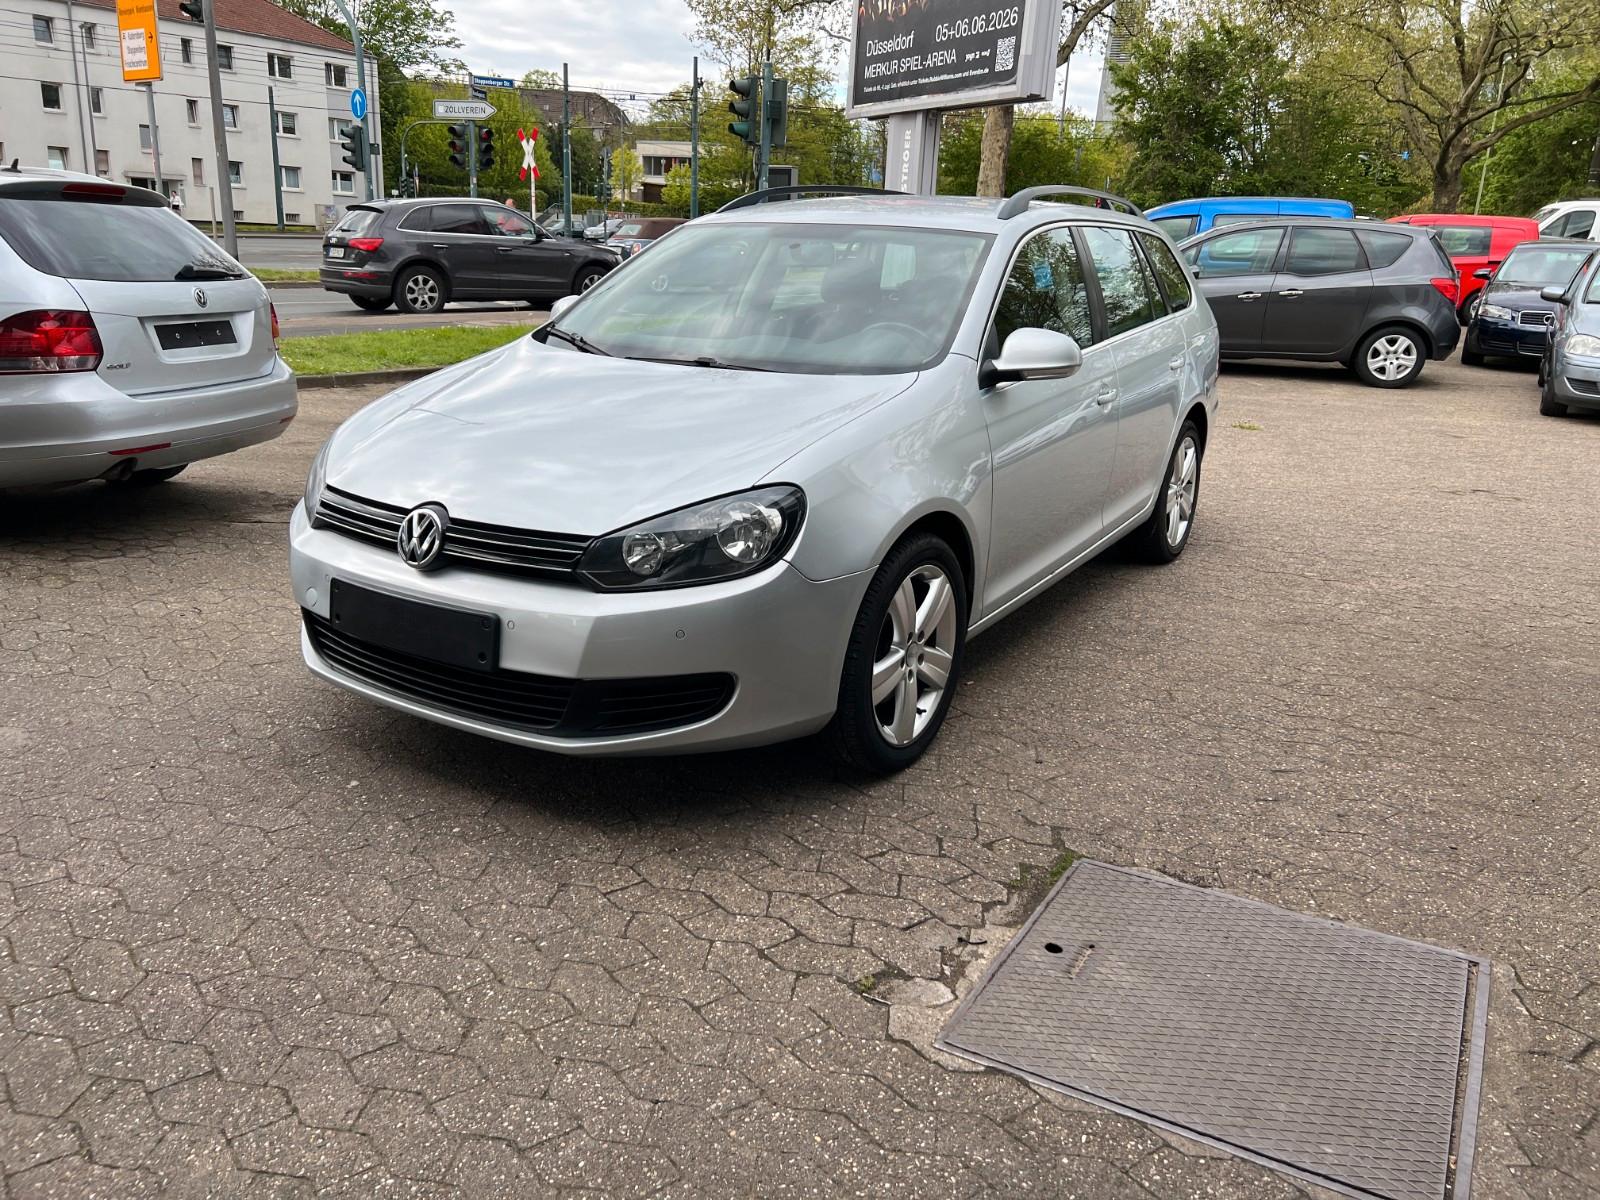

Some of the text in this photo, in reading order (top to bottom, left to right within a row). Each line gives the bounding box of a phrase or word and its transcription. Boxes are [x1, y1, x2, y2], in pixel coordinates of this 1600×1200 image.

[935, 6, 1019, 43] 05+06.06.2026
[866, 30, 915, 57] Düsseldorf
[864, 59, 899, 79] MERKUR
[900, 48, 957, 73] SPIEL-ARENA
[474, 77, 504, 87] Stoppenberger
[445, 105, 486, 114] ZOLLVEREIN
